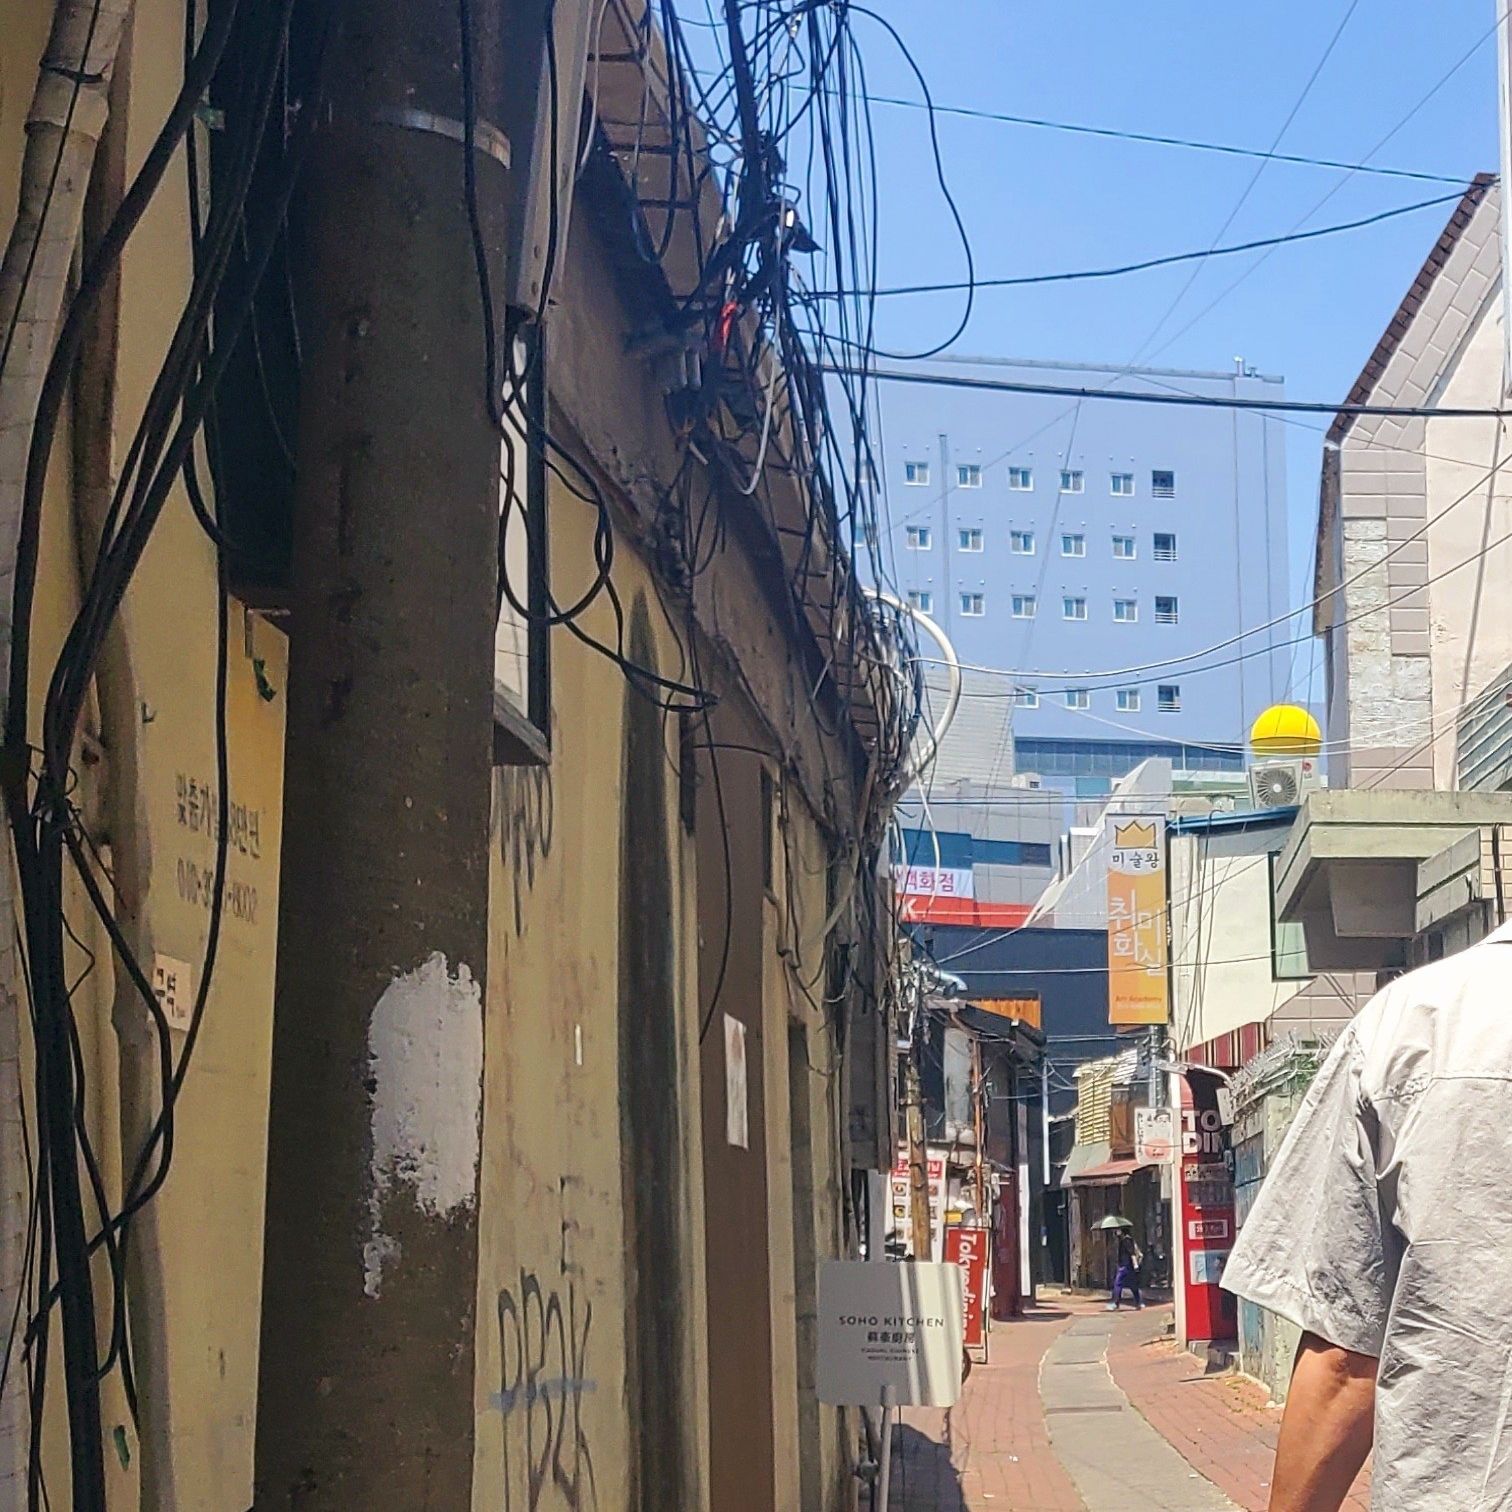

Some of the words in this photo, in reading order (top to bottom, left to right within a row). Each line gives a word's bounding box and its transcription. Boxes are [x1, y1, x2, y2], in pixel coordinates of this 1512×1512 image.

[1112, 851, 1160, 869] 미술왕
[1182, 1109, 1221, 1132] TO
[839, 1315, 878, 1326] SOHO
[884, 1316, 944, 1327] KITCHEN
